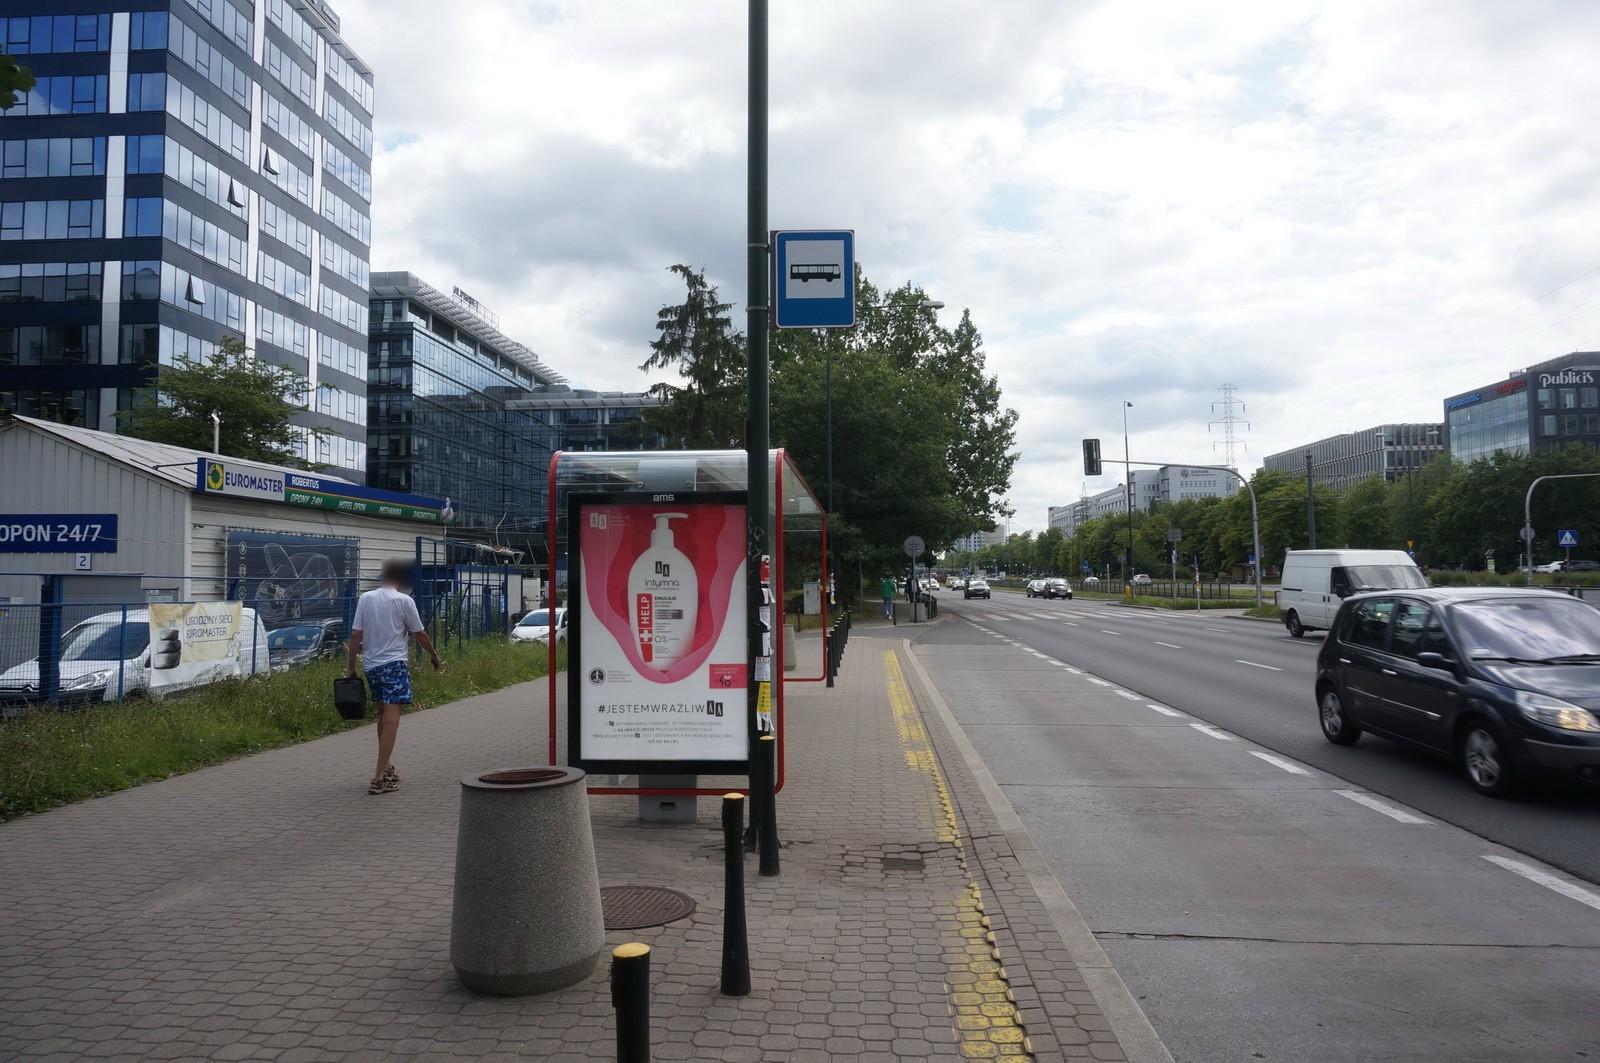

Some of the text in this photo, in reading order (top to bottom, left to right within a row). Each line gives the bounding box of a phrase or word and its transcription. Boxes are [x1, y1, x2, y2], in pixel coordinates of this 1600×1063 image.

[225, 471, 283, 494] EUROMASTER
[291, 475, 320, 489] ROBERTUS
[290, 493, 311, 504] OPONY
[652, 494, 675, 502] ams
[56, 524, 102, 542] 24/7
[79, 555, 87, 567] 2
[640, 596, 650, 625] HELP
